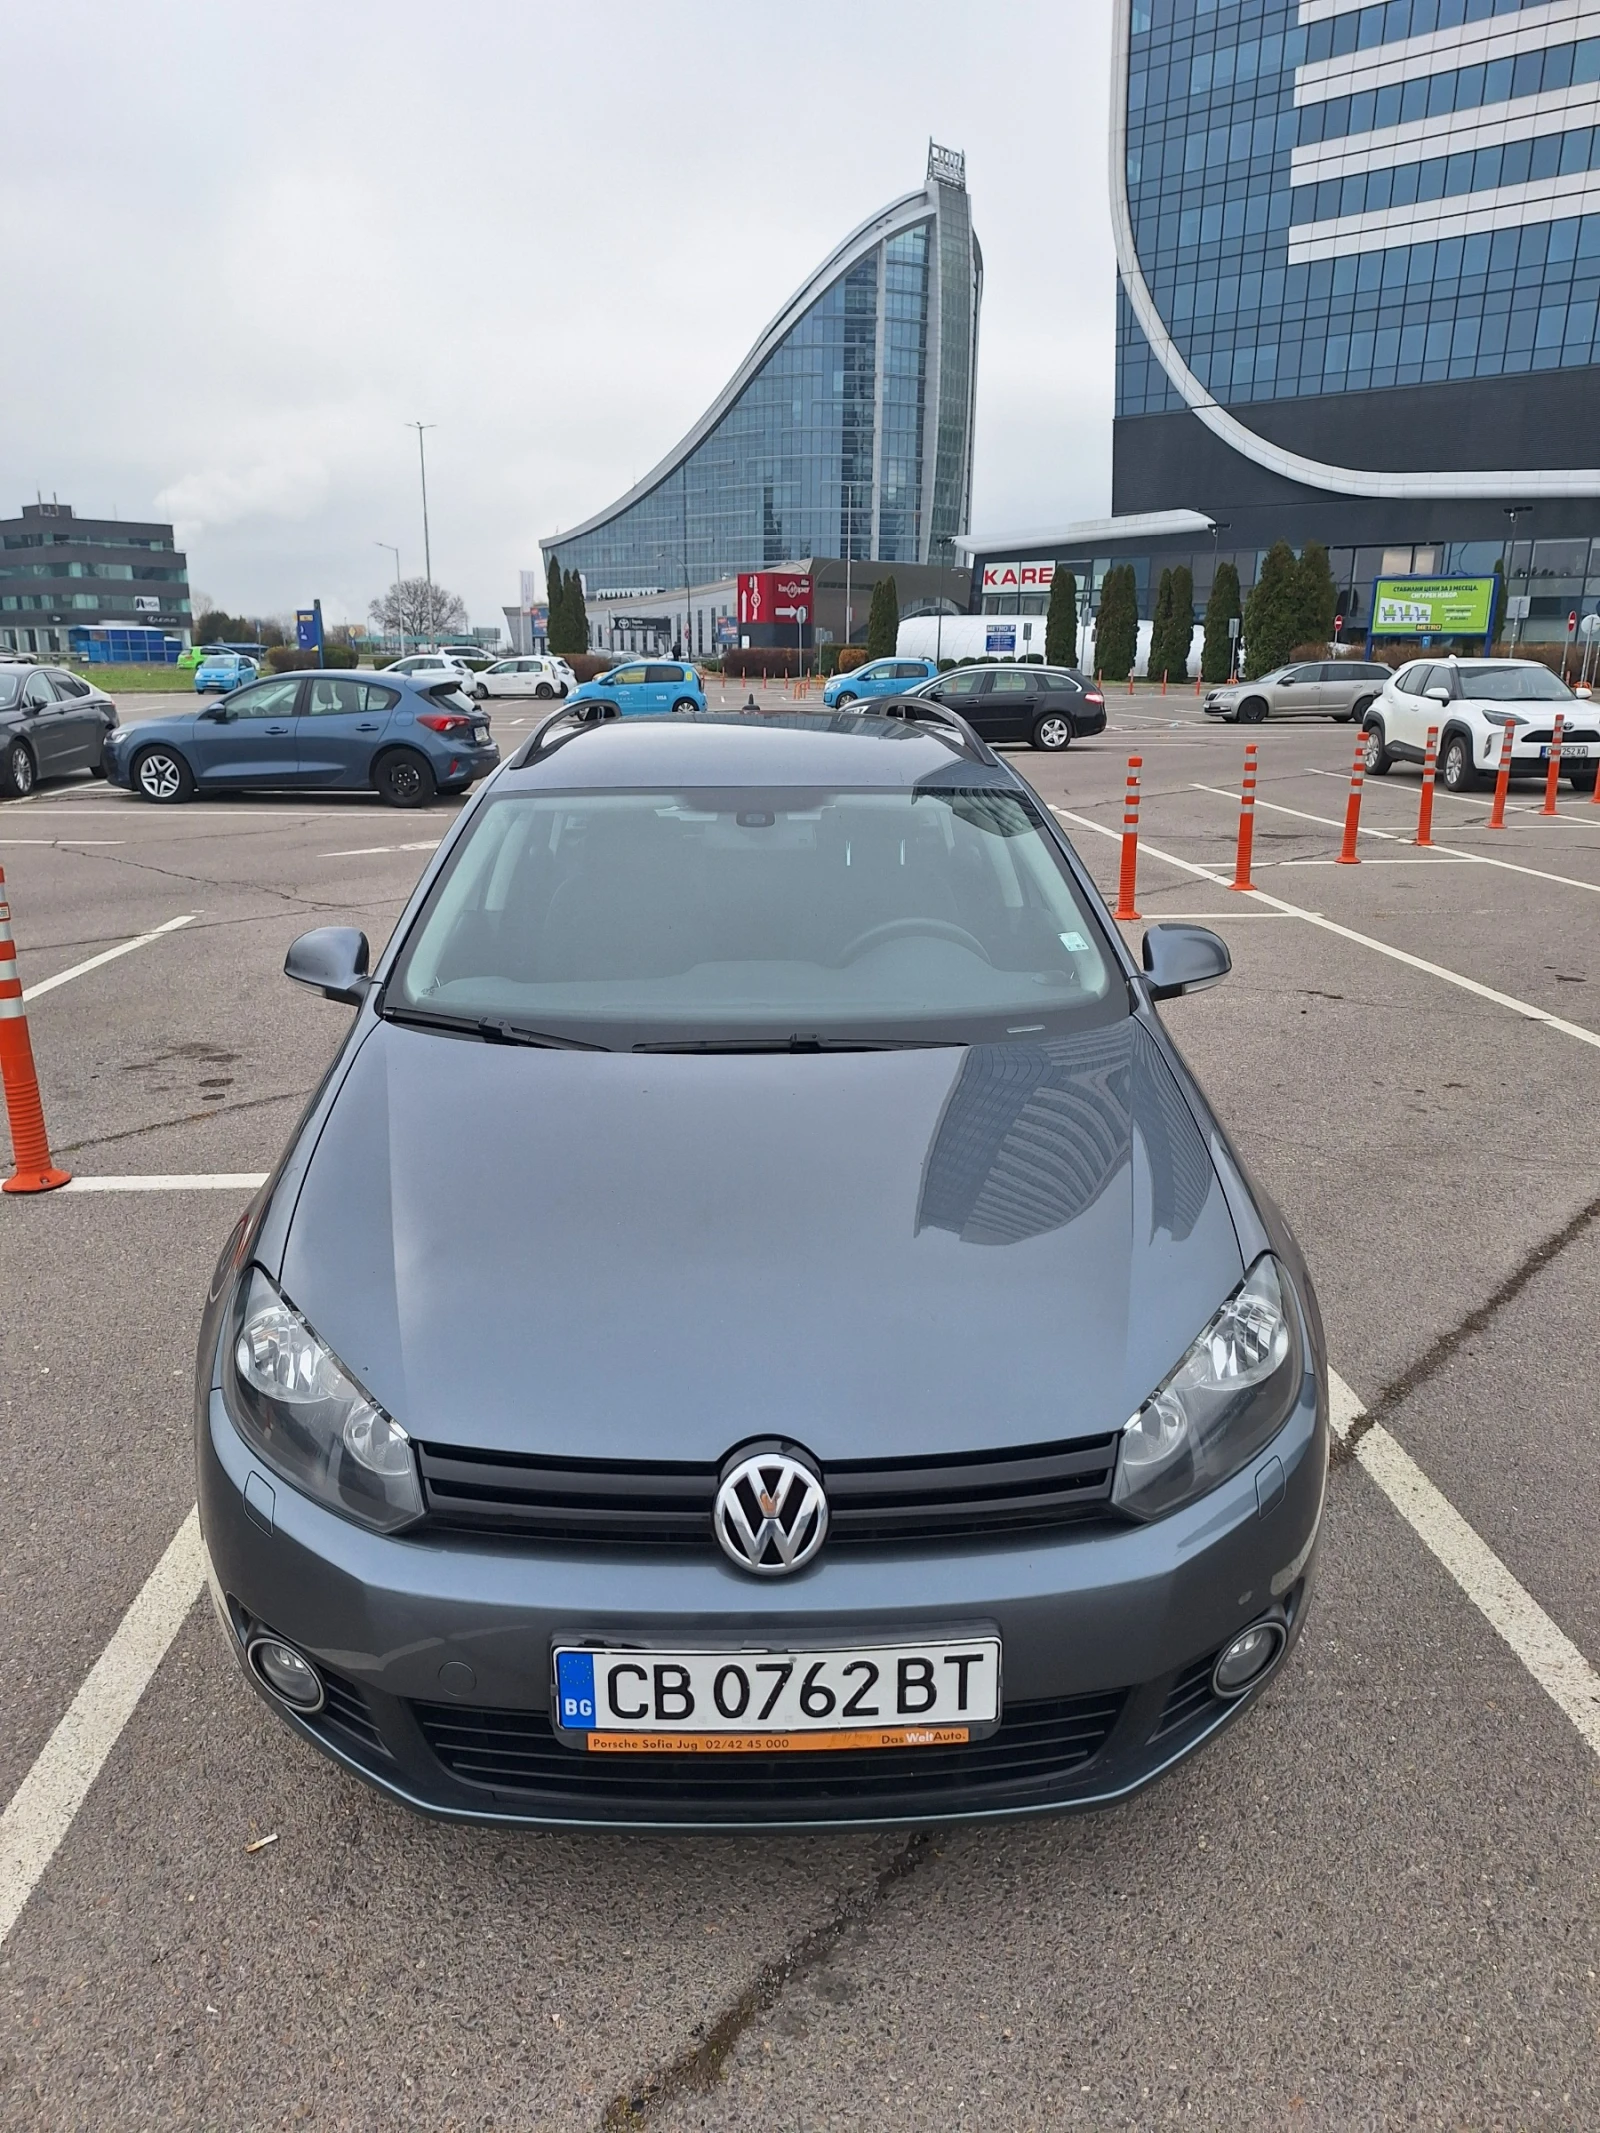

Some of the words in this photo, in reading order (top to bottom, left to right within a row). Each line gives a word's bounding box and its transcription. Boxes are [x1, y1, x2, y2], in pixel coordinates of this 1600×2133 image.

[984, 567, 1053, 586] KARE
[607, 1663, 696, 1720] CB
[713, 1660, 880, 1720] 0762
[897, 1653, 984, 1714] BT
[565, 1698, 592, 1716] BG
[594, 1738, 638, 1748] Porsche
[643, 1738, 673, 1748] Sofia
[677, 1740, 698, 1750] Jug
[706, 1740, 743, 1749] 02/42
[747, 1739, 762, 1748] 45
[766, 1739, 789, 1748] 000
[881, 1735, 904, 1744] Das
